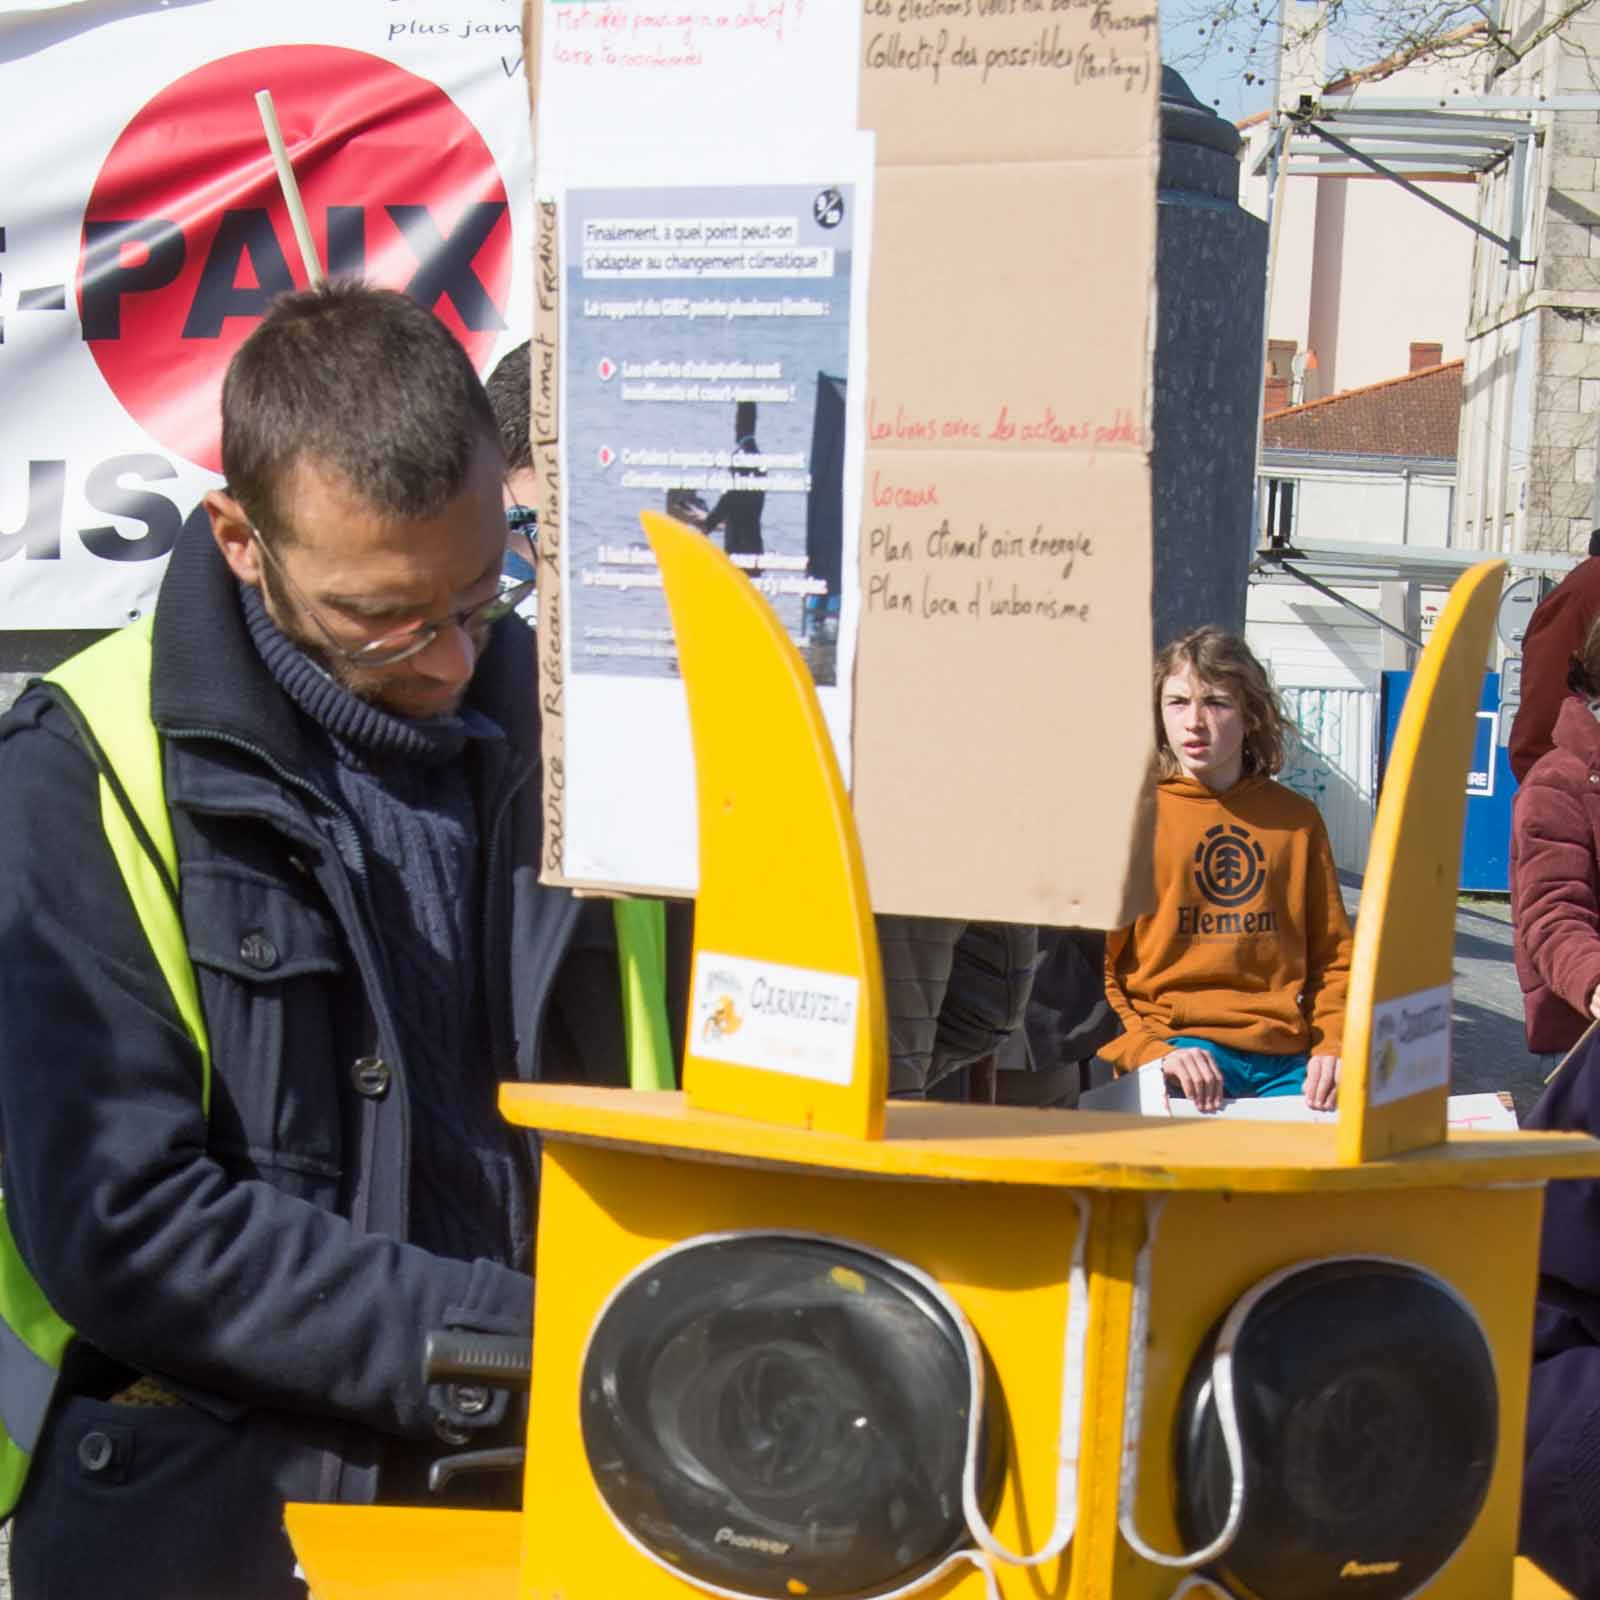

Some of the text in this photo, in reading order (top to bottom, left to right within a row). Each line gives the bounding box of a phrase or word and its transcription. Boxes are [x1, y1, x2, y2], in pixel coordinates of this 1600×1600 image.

[388, 20, 449, 41] plus
[984, 25, 1073, 83] possibles
[536, 195, 559, 312] FRANCE
[673, 223, 703, 247] quel
[705, 222, 739, 247] point
[740, 222, 793, 247] peut-on
[647, 256, 662, 270] au
[664, 253, 748, 275] changement
[749, 251, 819, 275] climatique
[535, 332, 558, 434] Climat
[537, 453, 560, 575] Actions
[870, 523, 913, 563] Plan
[868, 573, 913, 613] Plan
[540, 592, 562, 717] Réseau
[714, 1527, 790, 1554] Pioneer
